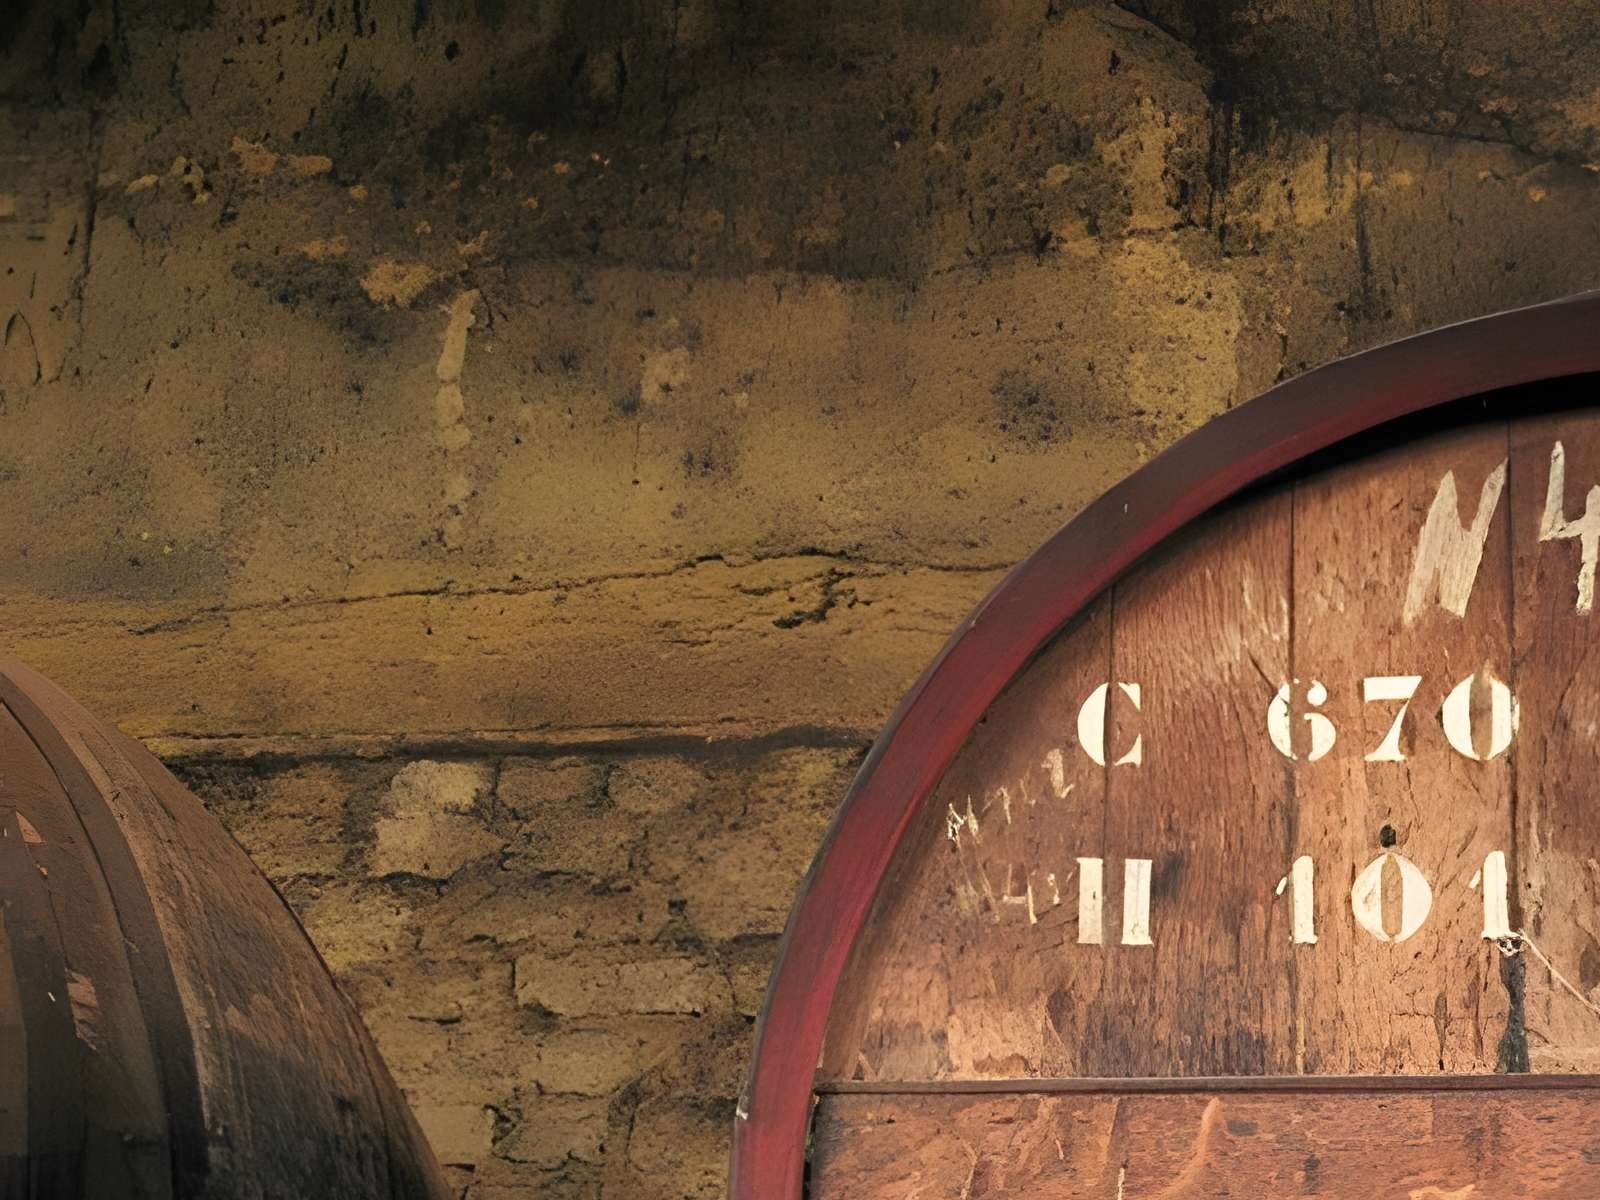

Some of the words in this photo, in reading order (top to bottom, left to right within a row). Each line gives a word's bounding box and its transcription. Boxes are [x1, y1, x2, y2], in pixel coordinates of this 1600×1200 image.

[1077, 681, 1142, 768] C
[1267, 672, 1520, 761] 670
[1275, 850, 1522, 944] 101
